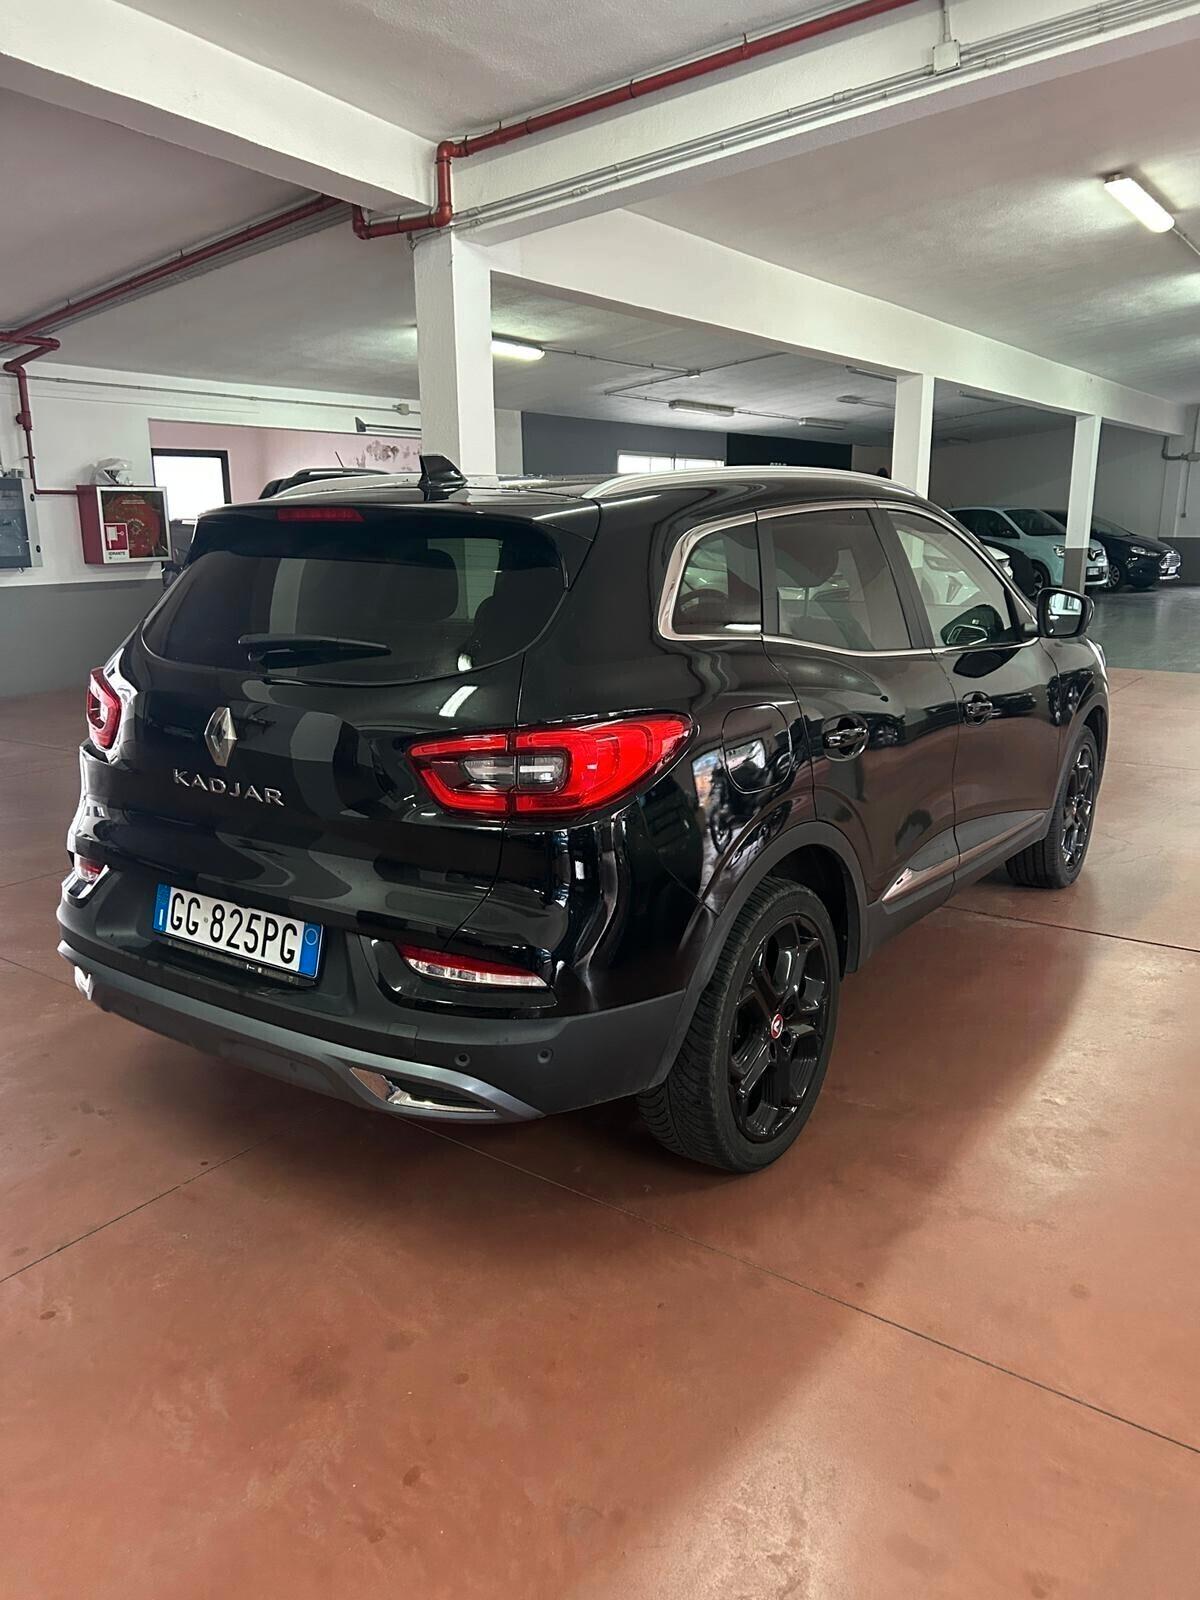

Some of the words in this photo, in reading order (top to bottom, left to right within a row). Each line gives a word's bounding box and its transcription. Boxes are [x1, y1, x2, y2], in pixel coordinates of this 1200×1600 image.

[172, 768, 285, 807] KADJAR
[170, 892, 201, 936] GG
[209, 904, 298, 964] 825PG
